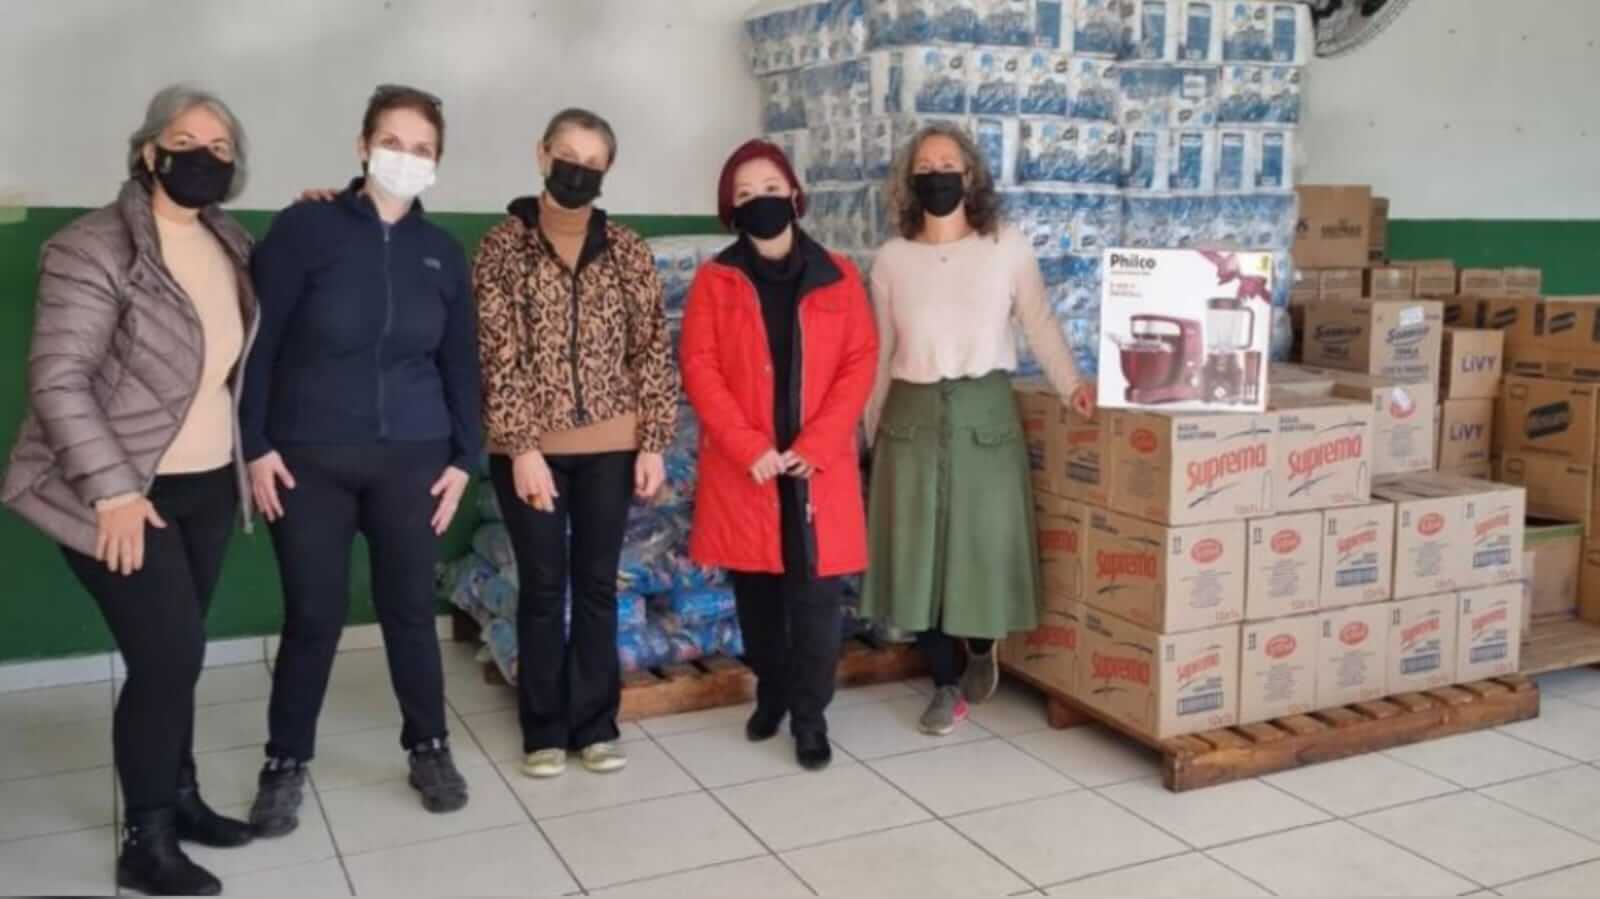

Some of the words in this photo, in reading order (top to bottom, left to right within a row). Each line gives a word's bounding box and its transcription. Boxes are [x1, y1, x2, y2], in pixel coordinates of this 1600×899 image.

[1110, 253, 1156, 269] Philco
[1186, 443, 1267, 493] Suprema
[1288, 434, 1362, 480] Suprema
[1096, 549, 1157, 583] Suprema
[1092, 652, 1151, 685] Suprema
